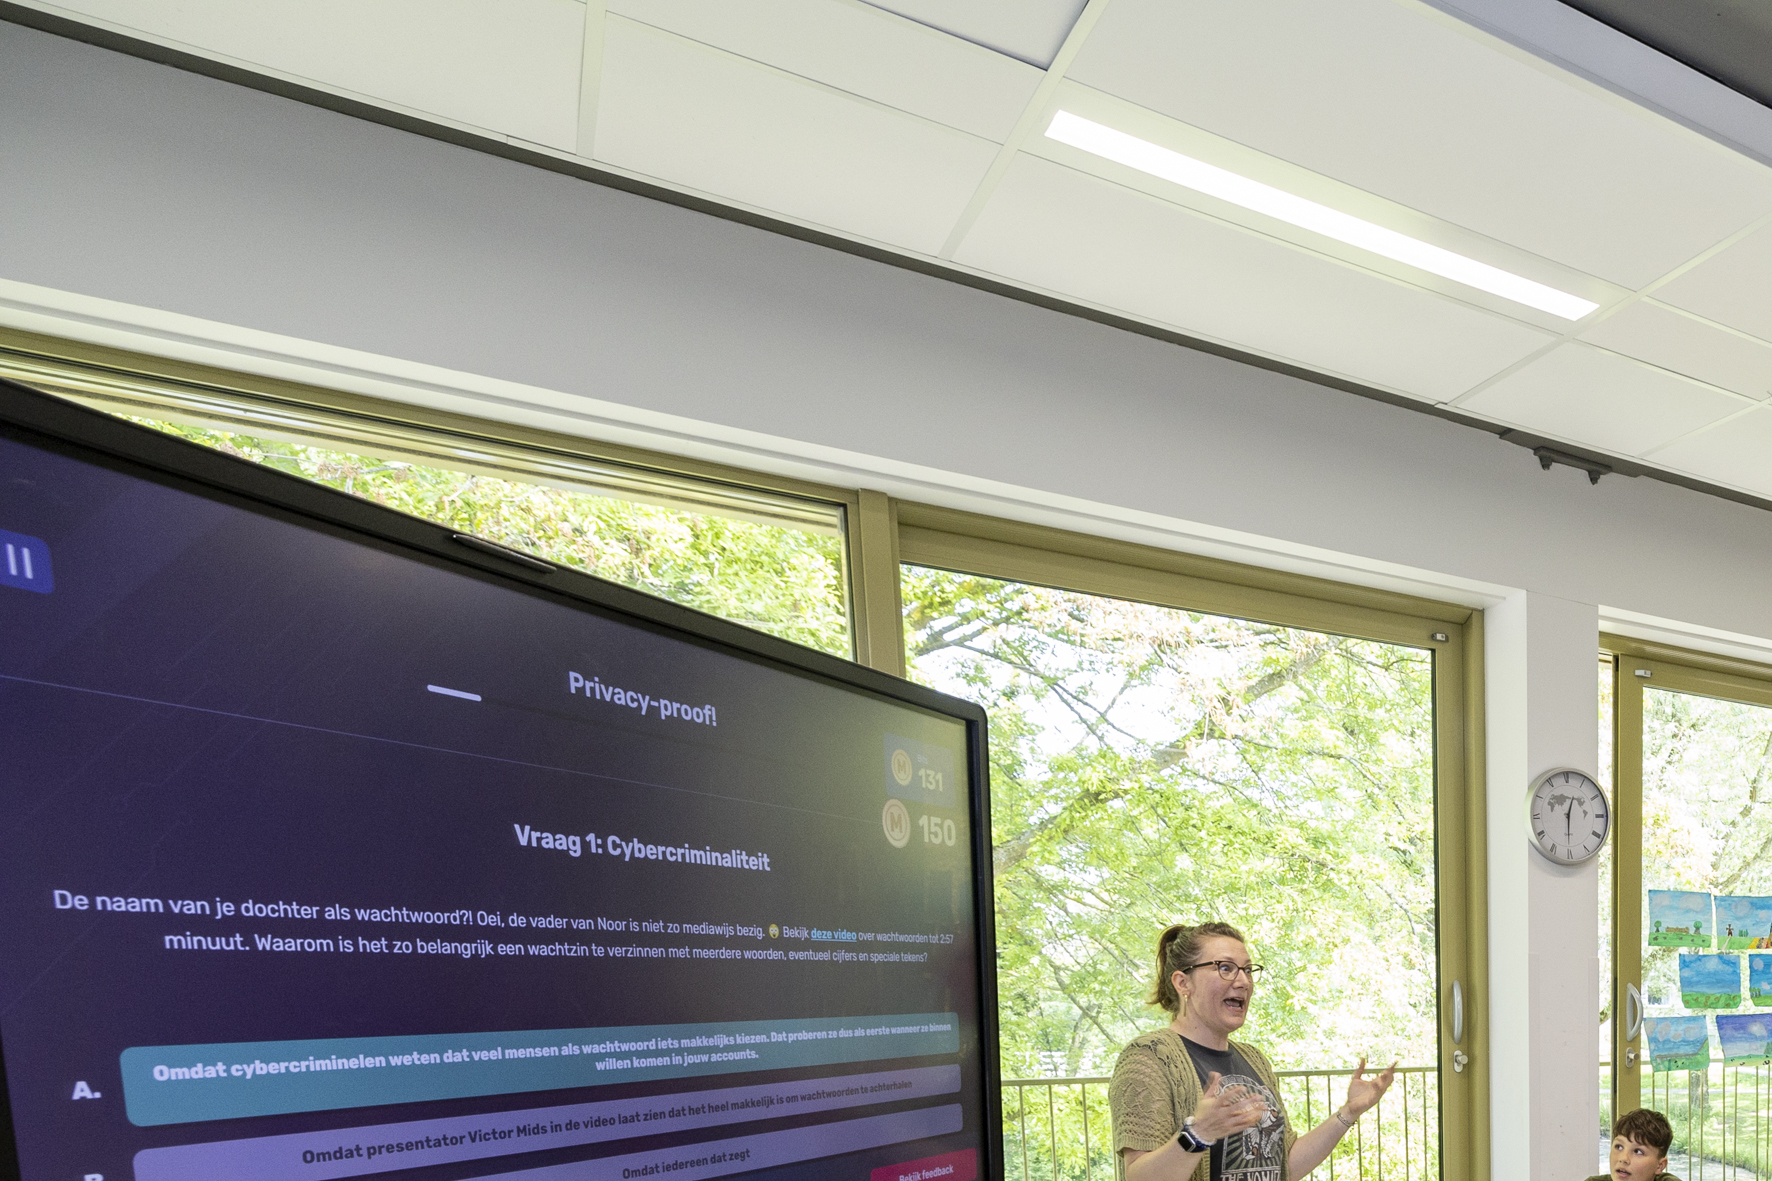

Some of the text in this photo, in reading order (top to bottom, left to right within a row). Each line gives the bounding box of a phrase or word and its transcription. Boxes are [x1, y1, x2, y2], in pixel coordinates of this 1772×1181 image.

[569, 671, 718, 726] Privacy-proof!
[919, 768, 943, 792] 131
[514, 824, 771, 871] Vraag 1: Cybercriminaliteit
[919, 815, 956, 847] 150
[53, 889, 90, 911] De
[95, 896, 165, 913] naam
[168, 899, 211, 915] van
[215, 897, 235, 920] je
[240, 899, 320, 920] dochter
[325, 904, 351, 921] als
[355, 906, 473, 926] wachtwoord?!
[477, 910, 505, 928] Oei,
[508, 913, 527, 928] de
[529, 914, 568, 930] vader
[570, 917, 595, 931] van
[598, 917, 627, 932] Noor
[629, 917, 640, 932] is
[642, 919, 665, 934] niet
[667, 922, 681, 935] zo
[682, 921, 735, 938] mediawijs
[737, 923, 766, 941] bezig.
[782, 925, 810, 941] Bekijk
[810, 928, 834, 941] deze
[833, 928, 858, 942] video
[858, 932, 876, 942] over
[876, 930, 929, 944] wachtwoorden
[929, 932, 939, 945] tot
[164, 931, 928, 964] minuut. Waarom is het zo belangrijk een wachtzin te verzinnen met meerdere woorden, eventueel cijfers en speciale tekens?
[152, 1022, 952, 1082] Omdat cybercriminelen weten dat veel mensen als wachtwoord iets makkelijks kiezen. Dat proberen ze dus als eerste wanneer ze binnen
[595, 1049, 760, 1073] willen komen in jouw accounts.
[72, 1080, 102, 1100] A.
[302, 1079, 913, 1165] Omdat presentator Victor Mids in de video laat zien dat het heel makkelijk is om wachtwoorden te achterhalen
[622, 1148, 752, 1181] Omdat iedereen dat zegt
[921, 1163, 955, 1181] feedback
